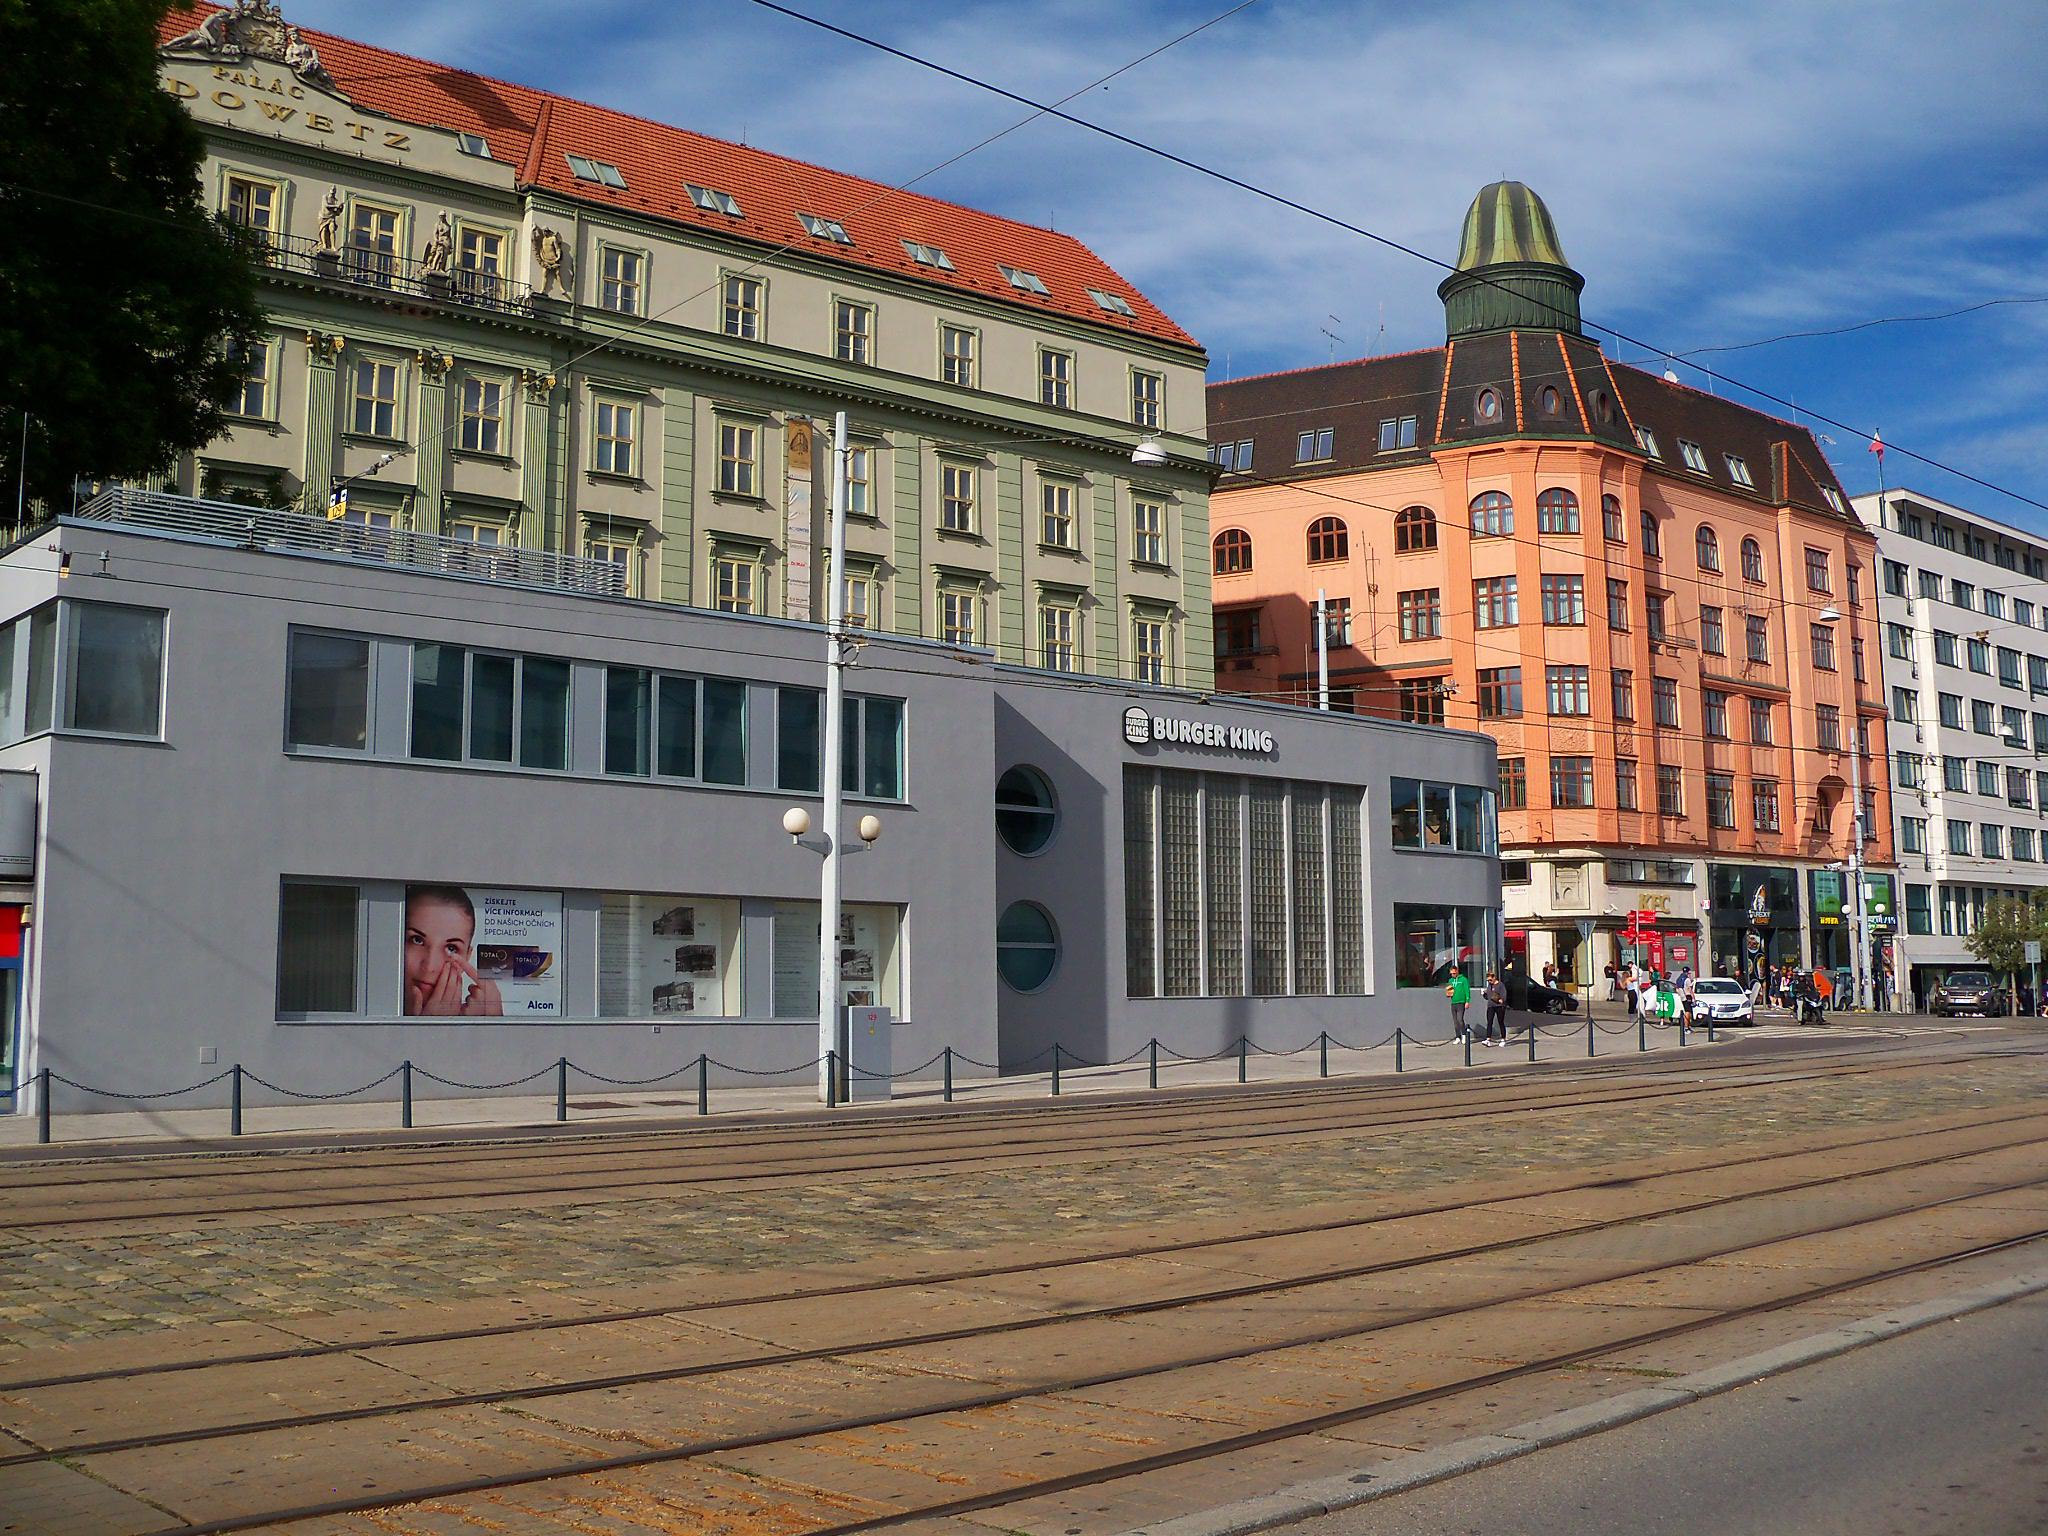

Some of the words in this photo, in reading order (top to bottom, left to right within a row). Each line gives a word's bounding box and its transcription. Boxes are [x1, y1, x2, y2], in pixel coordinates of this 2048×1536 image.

[212, 65, 305, 99] PALÁC
[1125, 717, 1149, 727] BURGER
[1125, 724, 1149, 737] KING
[1153, 716, 1226, 748] BURGER
[1229, 726, 1273, 753] KING
[484, 907, 503, 916] VÍCE
[503, 908, 543, 917] INFORMACÍ
[484, 918, 496, 926] OD
[497, 917, 524, 927] NAŠICH
[525, 918, 555, 928] OČNÍCH
[484, 927, 528, 937] SPECIALISTŮ
[527, 1000, 554, 1010] Alcon
